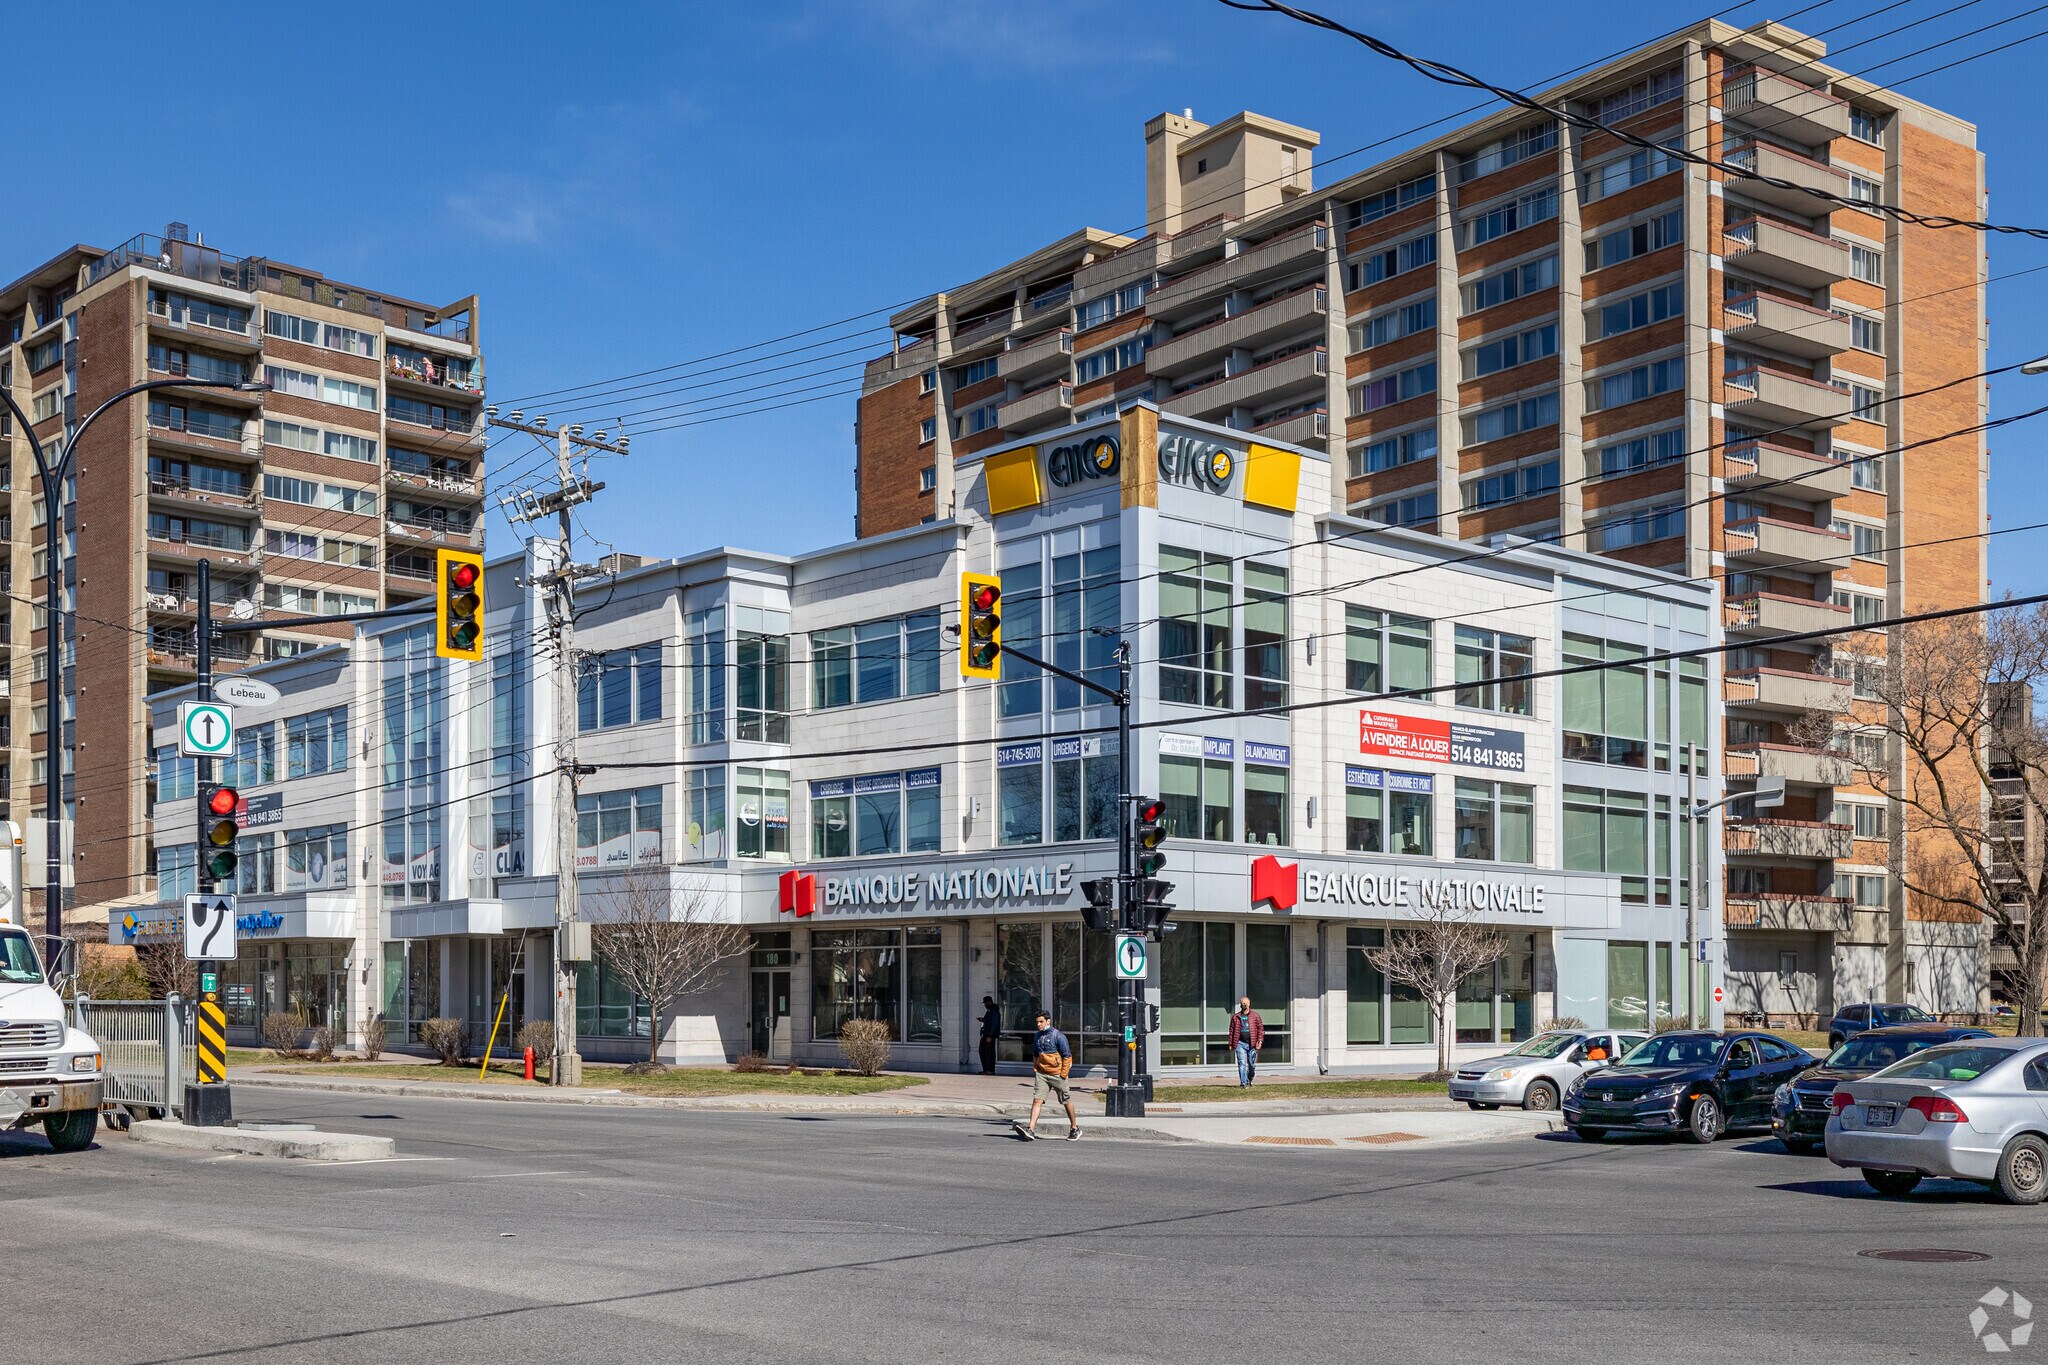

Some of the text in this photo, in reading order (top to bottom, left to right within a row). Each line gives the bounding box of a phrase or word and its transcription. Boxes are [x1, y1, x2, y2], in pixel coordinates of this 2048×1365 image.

[230, 687, 266, 700] Lebeau
[1053, 741, 1080, 756] URGENCE
[1204, 740, 1231, 755] IMPLANT
[1362, 728, 1449, 754] À VENDRE À LOUER
[997, 746, 1041, 762] 514-745-5078
[1245, 745, 1286, 761] BLANCHIMENT
[1451, 744, 1523, 769] 514 841 3865
[910, 771, 937, 786] DENTISTE
[1347, 770, 1380, 785] ESTHÉTIQUE
[258, 811, 267, 823] 841
[268, 808, 282, 821] 3865
[825, 863, 1073, 906] BANQUE NATIONALE
[1303, 869, 1546, 913] BANQUE NATIONALE
[766, 953, 779, 965] 180
